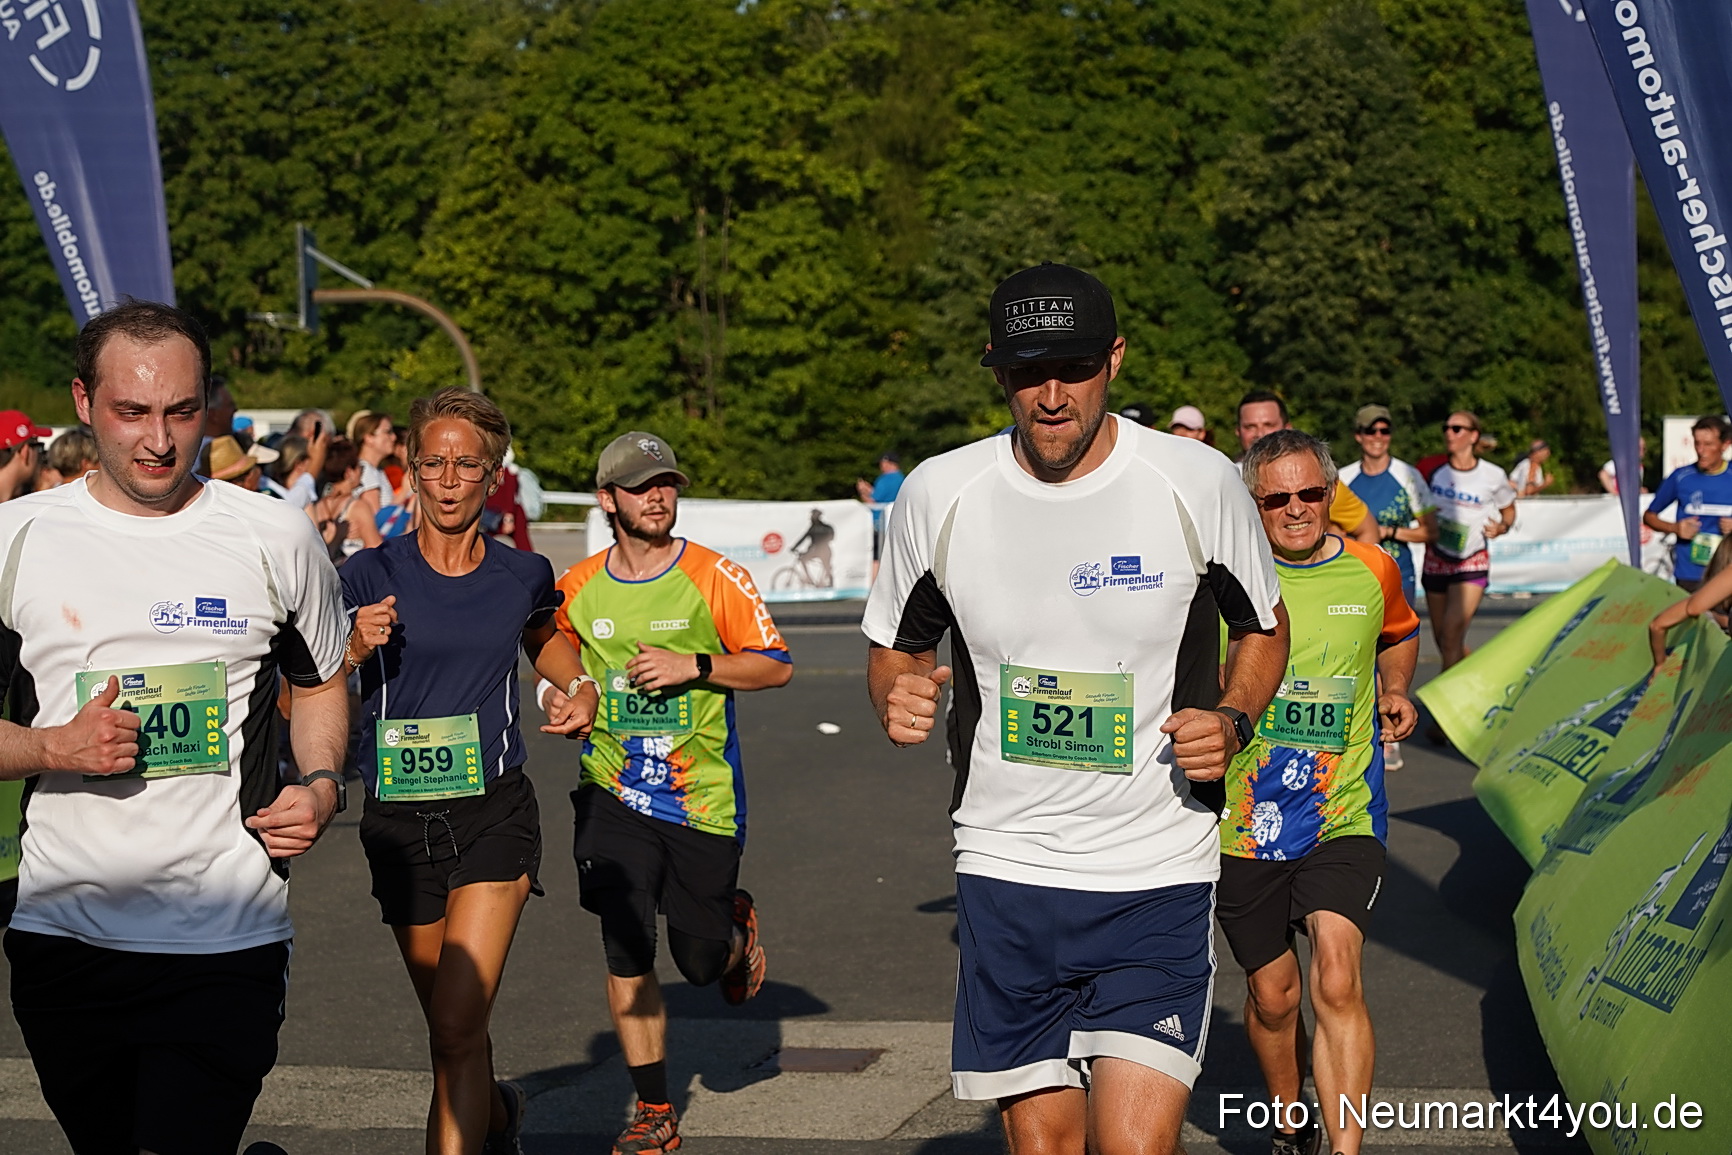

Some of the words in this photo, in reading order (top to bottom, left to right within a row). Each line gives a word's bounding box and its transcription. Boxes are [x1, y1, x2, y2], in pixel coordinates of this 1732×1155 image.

[1006, 316, 1075, 333] GÖSCHBERG
[1103, 572, 1164, 587] Firmenlauf
[1127, 581, 1164, 592] neumarkt
[1328, 605, 1367, 616] BOCK
[186, 616, 249, 628] Firmenlauf
[651, 619, 690, 632] BOCK
[134, 693, 162, 701] neumarkt
[1032, 687, 1073, 696] Firmenlauf
[610, 698, 619, 722] RUN
[626, 693, 669, 715] 628
[678, 695, 688, 726] 2022
[133, 702, 191, 740] 40
[1032, 703, 1093, 738] 521
[1266, 704, 1276, 730] RUN
[1285, 701, 1335, 727] 618
[206, 705, 220, 756] 2022
[1007, 709, 1019, 743] RUN
[1306, 728, 1343, 739] Manfred
[400, 733, 430, 741] Firmenlauf
[1026, 736, 1061, 750] Strobl
[1064, 740, 1104, 753] Simon
[1114, 713, 1126, 758] 2022
[172, 740, 200, 754] Maxi
[401, 746, 453, 774] 959
[465, 746, 478, 784] 2022
[383, 757, 393, 785] RUN
[392, 776, 421, 786] Stengel
[423, 773, 468, 785] Stephanie
[1153, 1023, 1185, 1041] adidas
